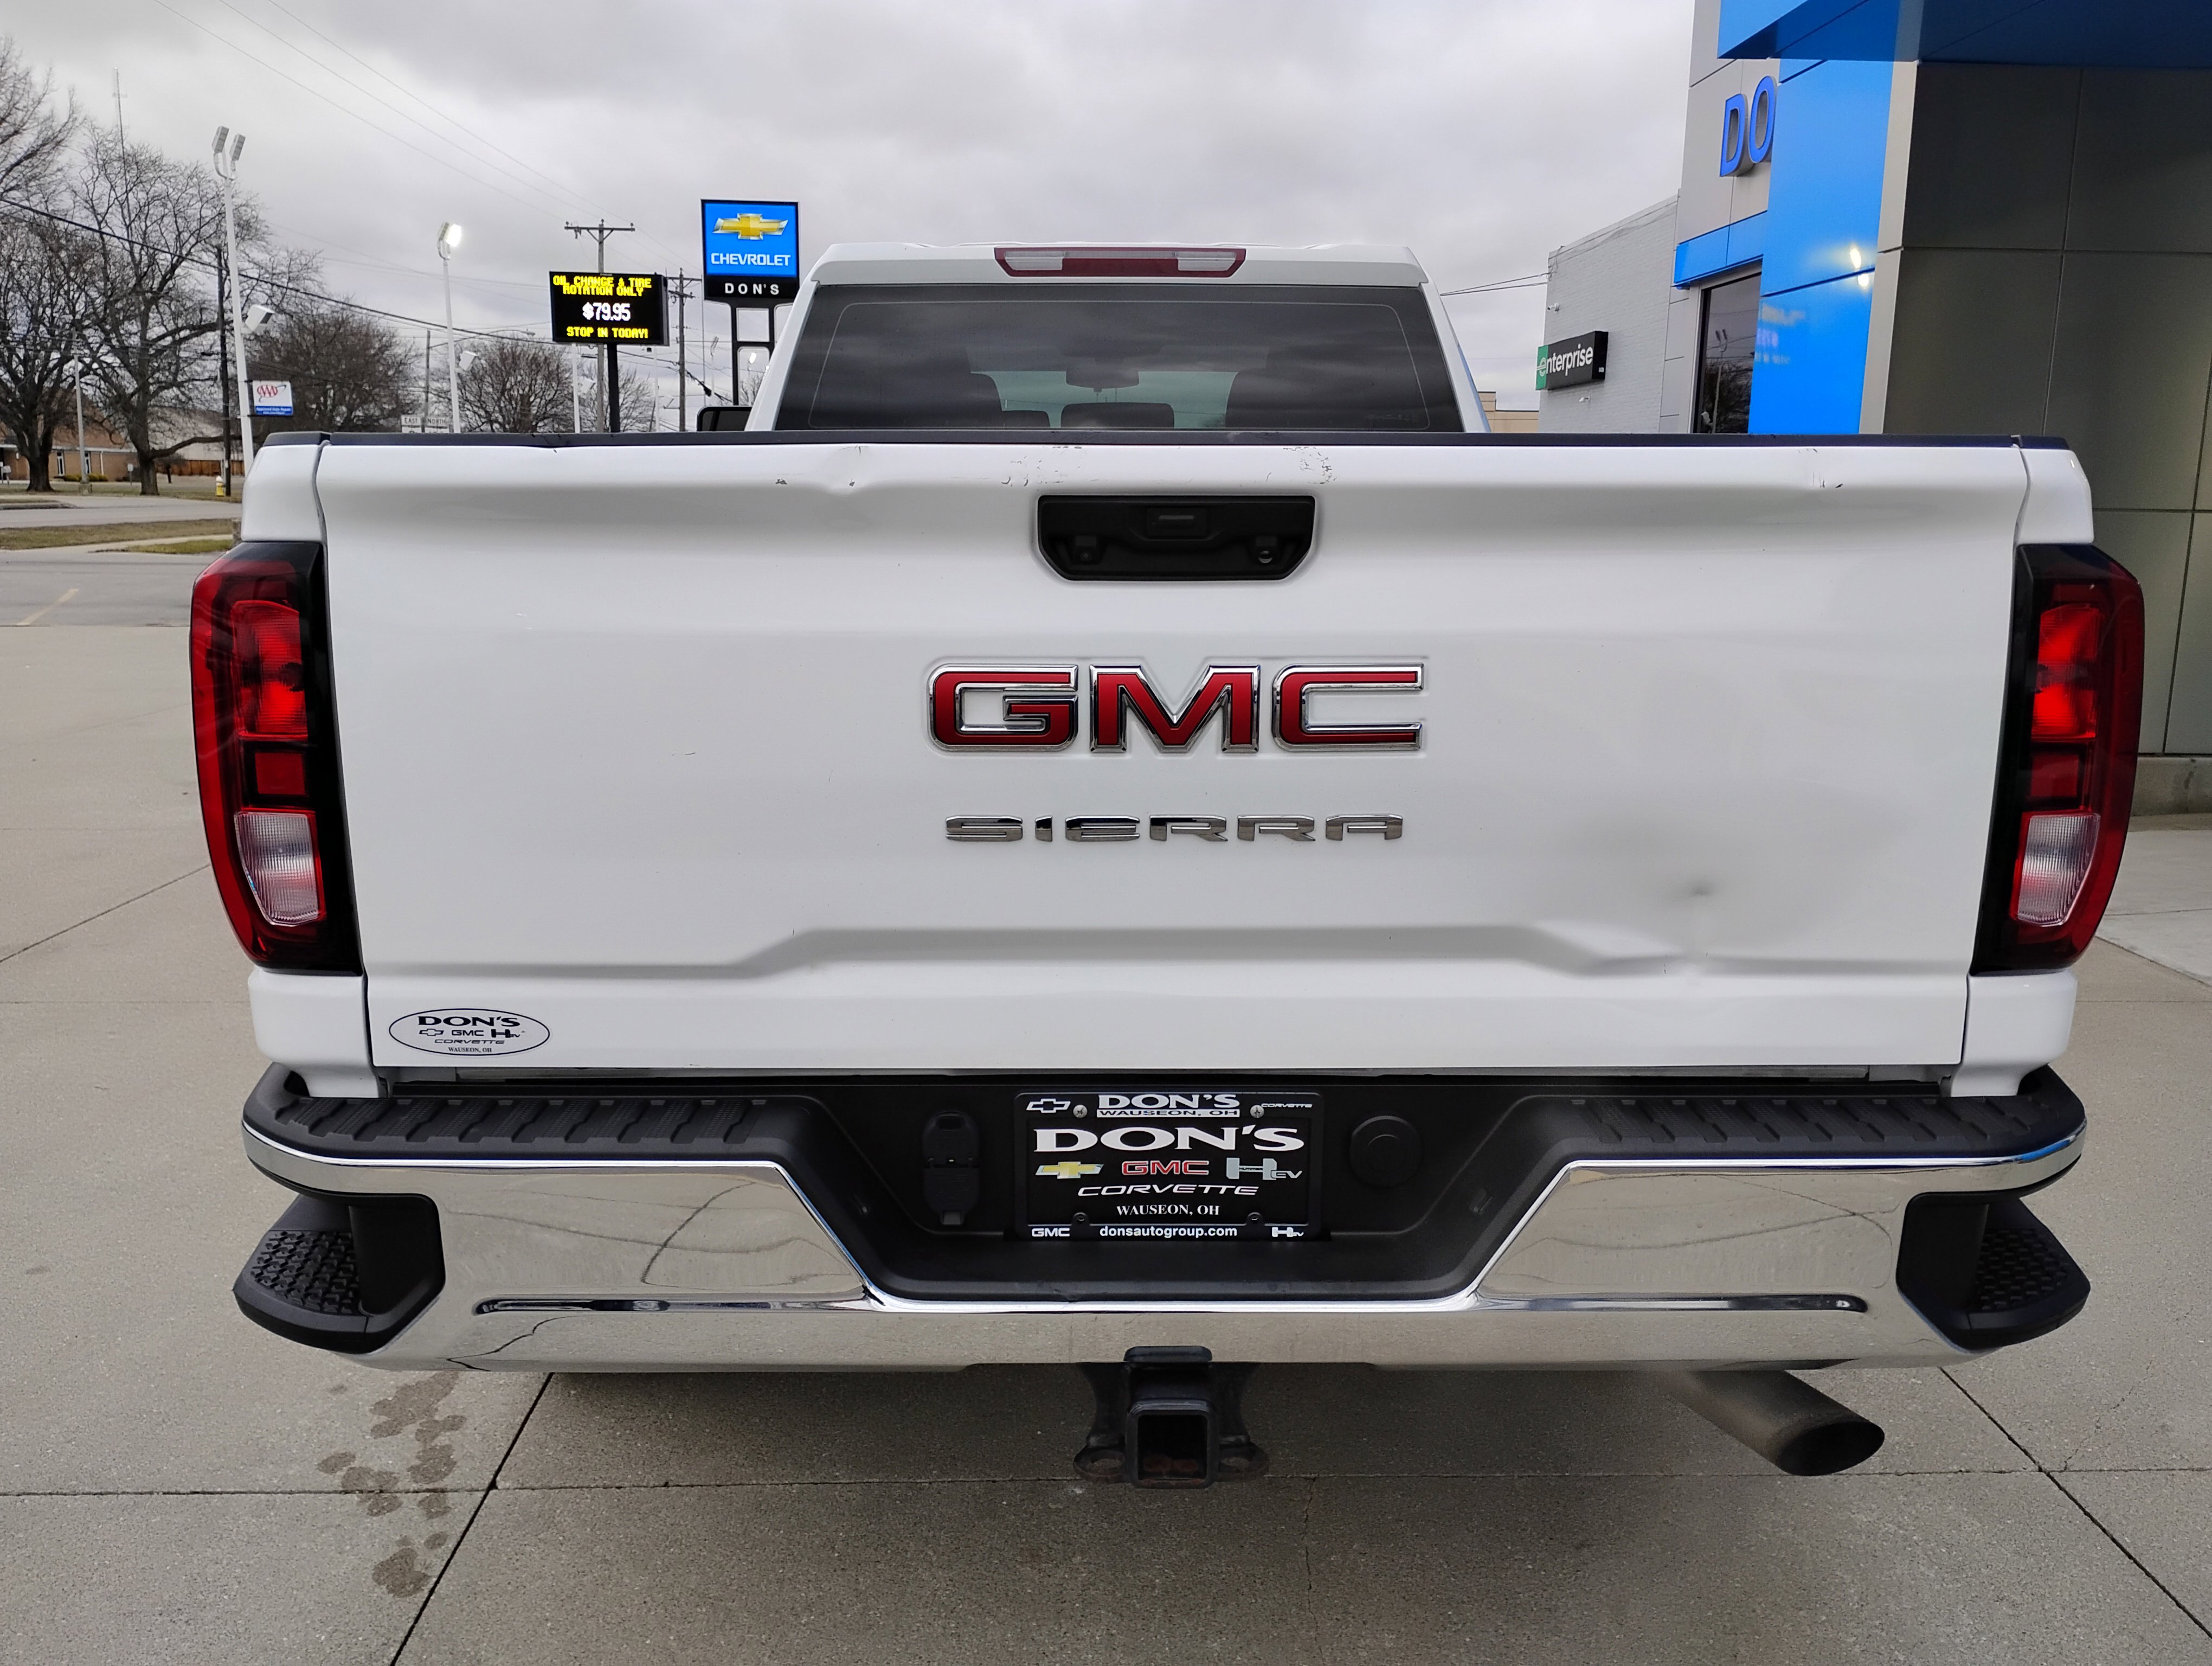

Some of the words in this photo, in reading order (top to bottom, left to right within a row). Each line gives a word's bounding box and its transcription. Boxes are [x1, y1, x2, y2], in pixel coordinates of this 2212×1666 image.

[711, 253, 791, 266] CHEVROLET
[552, 275, 569, 286] OIL
[573, 275, 614, 287] CHANGE
[618, 277, 625, 287] &
[628, 277, 652, 288] TIRE
[563, 284, 613, 296] ROTATION
[616, 286, 644, 297] ONLY
[724, 283, 780, 295] DON'S
[582, 302, 631, 321] $79.95
[566, 326, 594, 337] STOP
[597, 327, 608, 337] IN
[612, 328, 648, 338] TODAY!
[1536, 343, 1594, 376] enterprise
[257, 385, 278, 398] AAA
[929, 663, 1425, 753] GMC
[945, 815, 1404, 842] SIERRA
[417, 1016, 520, 1027] DON'S
[1098, 1094, 1240, 1108] DON'S
[1033, 1124, 1304, 1152] DON'S
[1121, 1160, 1210, 1176] GMC
[1078, 1184, 1259, 1196] CORVETTE
[1116, 1204, 1193, 1215] WAUSEON,
[1197, 1205, 1220, 1215] OH
[1031, 1227, 1070, 1237] GMC
[1099, 1226, 1237, 1238] donsautogroup.com
